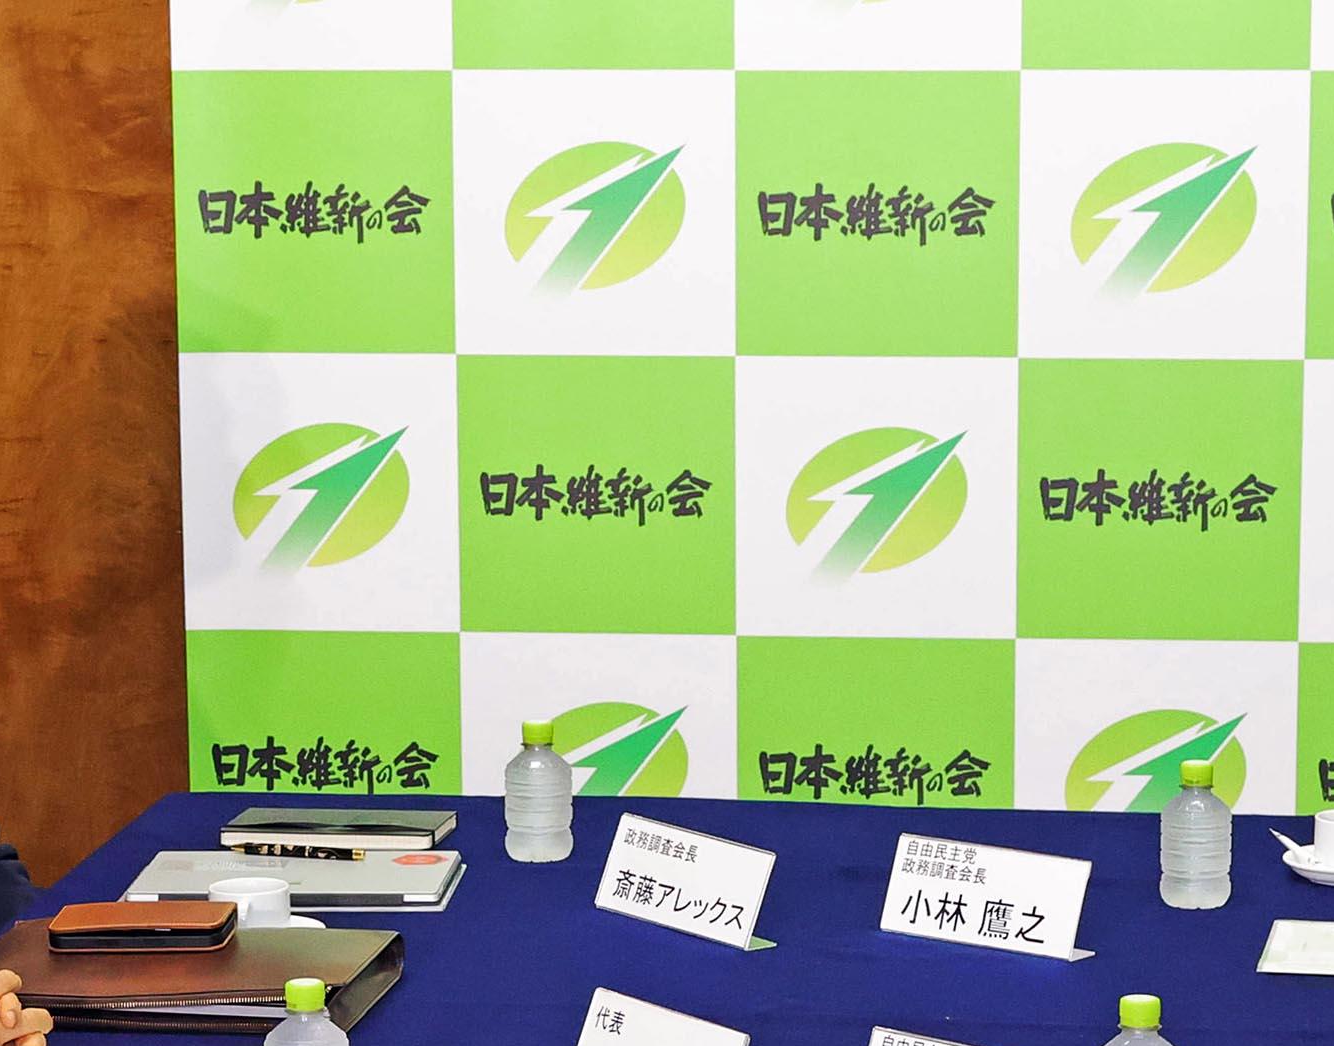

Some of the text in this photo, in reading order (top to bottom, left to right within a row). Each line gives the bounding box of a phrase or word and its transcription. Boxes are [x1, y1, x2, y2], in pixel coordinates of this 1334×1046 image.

[197, 180, 431, 245] 日本維新の会
[757, 183, 996, 246] 日本維新の会
[479, 464, 712, 527] 日本維新の会
[1039, 468, 1278, 532] 日本維新の会
[211, 736, 439, 796] 日本維新の会
[759, 743, 992, 806] 日本維新の会
[623, 828, 698, 863] 政務調査会長
[901, 857, 987, 885] 政務調査会長
[906, 840, 977, 866] 自由民主党
[612, 869, 744, 930] 斎藤アレックス
[900, 889, 1046, 944] 小林 鷹之
[595, 1005, 626, 1035] 代表
